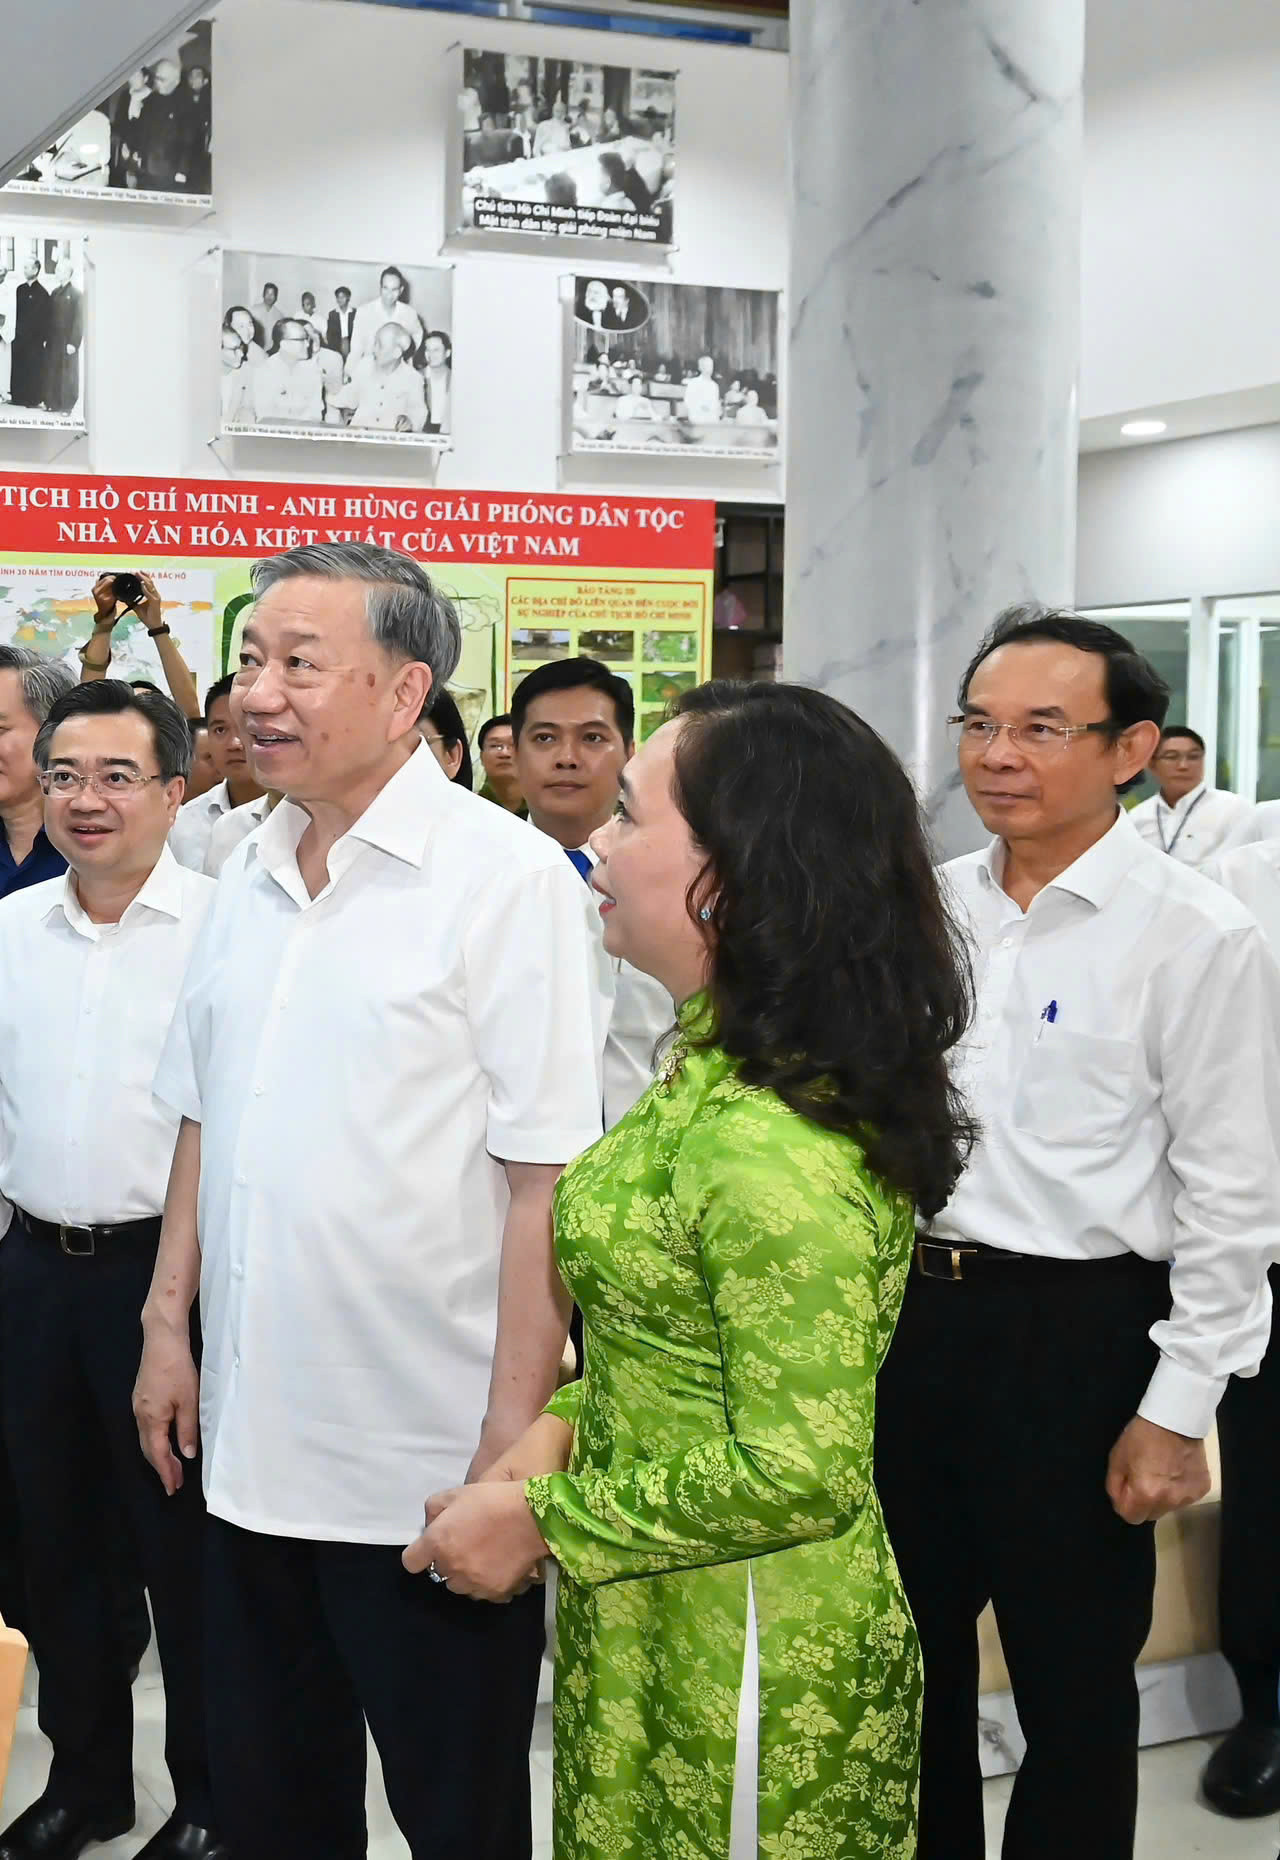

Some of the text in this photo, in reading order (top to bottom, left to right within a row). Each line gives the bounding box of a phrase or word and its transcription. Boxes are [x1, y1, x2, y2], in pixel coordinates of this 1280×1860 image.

[0, 485, 70, 512] TỊCH
[79, 482, 120, 511] HỒ
[128, 484, 177, 513] CHÍ
[186, 493, 258, 515] MINH
[280, 496, 337, 517] ANH
[344, 493, 417, 520] HÙNG
[425, 495, 481, 522] GIẢI
[487, 499, 574, 526] PHÓNG
[580, 501, 632, 528] DÂN
[635, 506, 685, 532] TỘC
[57, 517, 118, 543] NHÀ
[127, 519, 182, 545] VĂN
[190, 521, 249, 547] HÓA
[410, 528, 455, 552] CỦA
[460, 532, 519, 557] VIỆT
[524, 535, 580, 556] NAM
